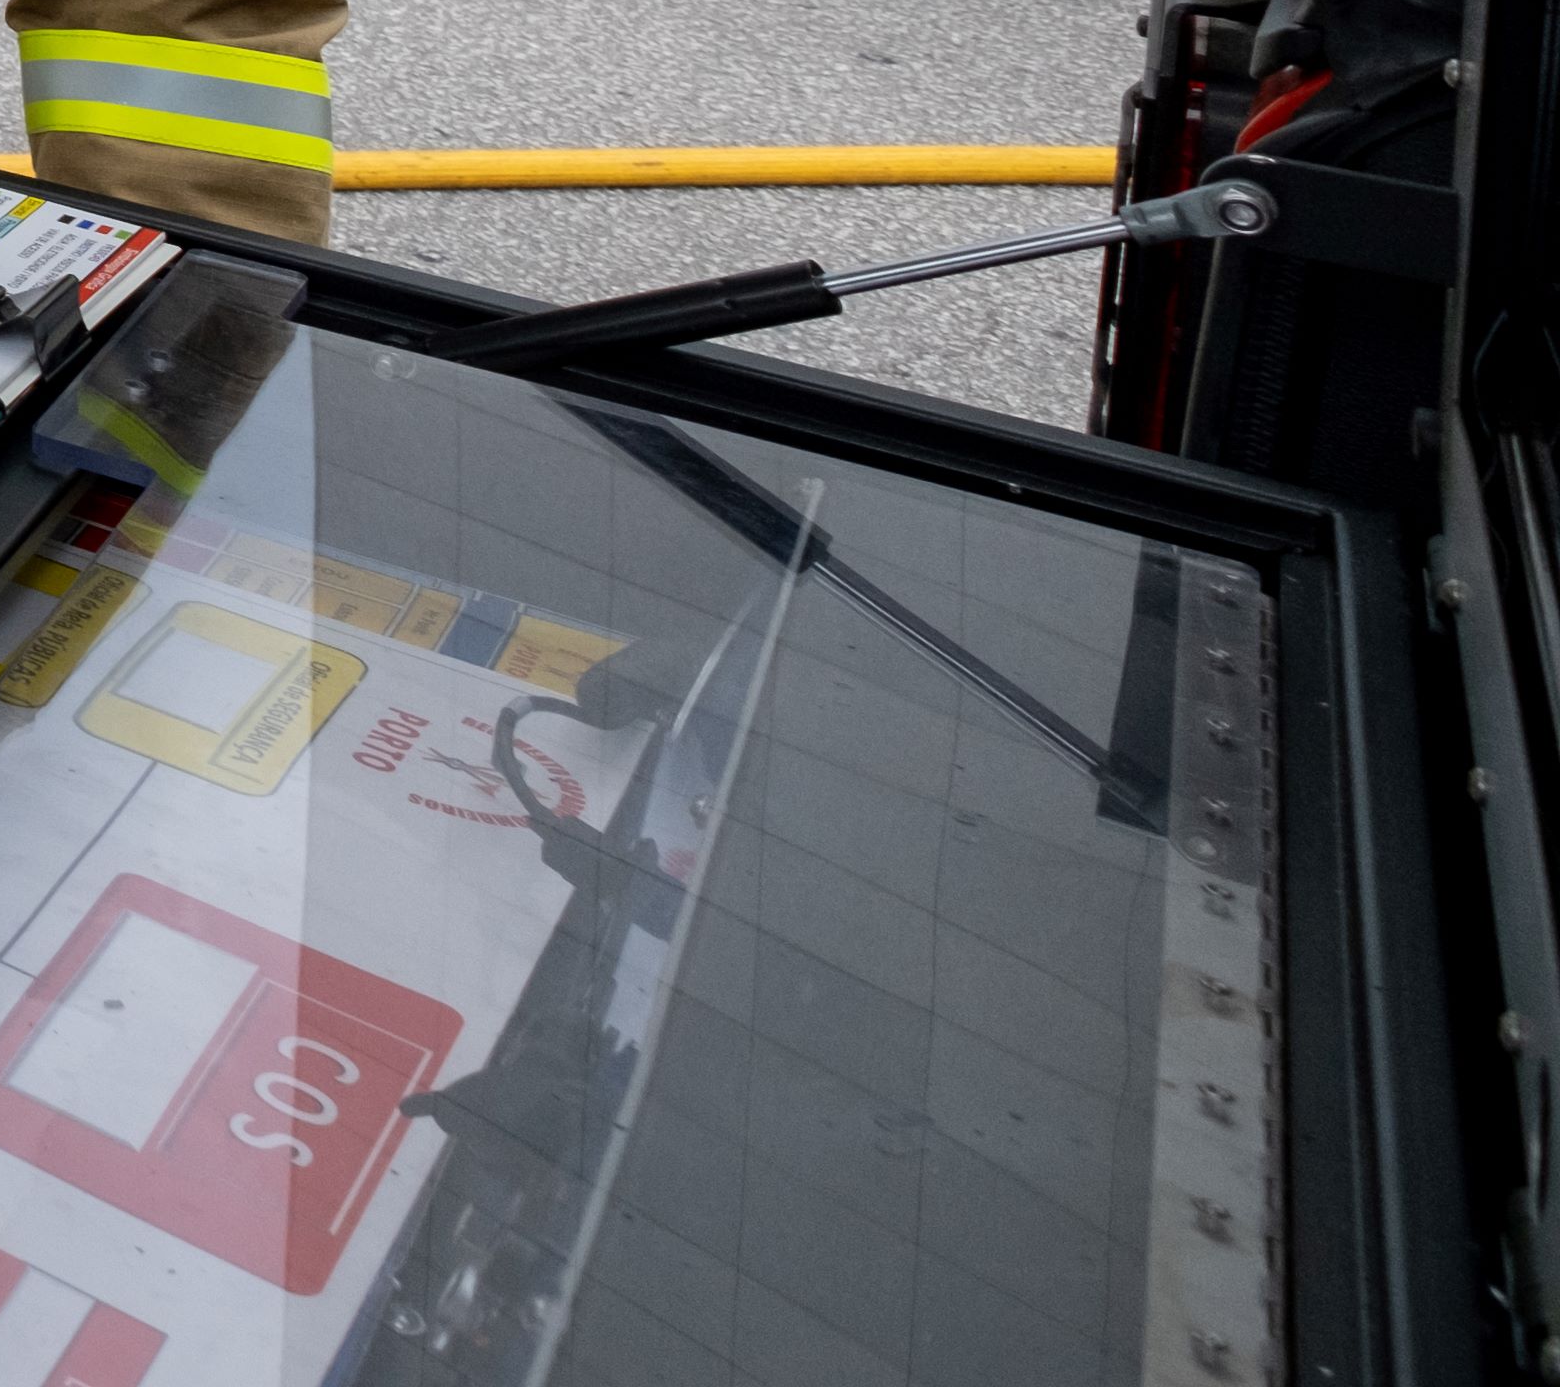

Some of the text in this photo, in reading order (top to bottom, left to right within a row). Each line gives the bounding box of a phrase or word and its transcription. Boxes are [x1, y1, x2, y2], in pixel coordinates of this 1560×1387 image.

[75, 596, 100, 614] de
[5, 628, 70, 689] PÚBLICAS
[282, 684, 307, 703] de
[228, 695, 301, 769] SEGURANÇA
[353, 708, 430, 773] PORTO
[229, 1035, 361, 1168] COS
